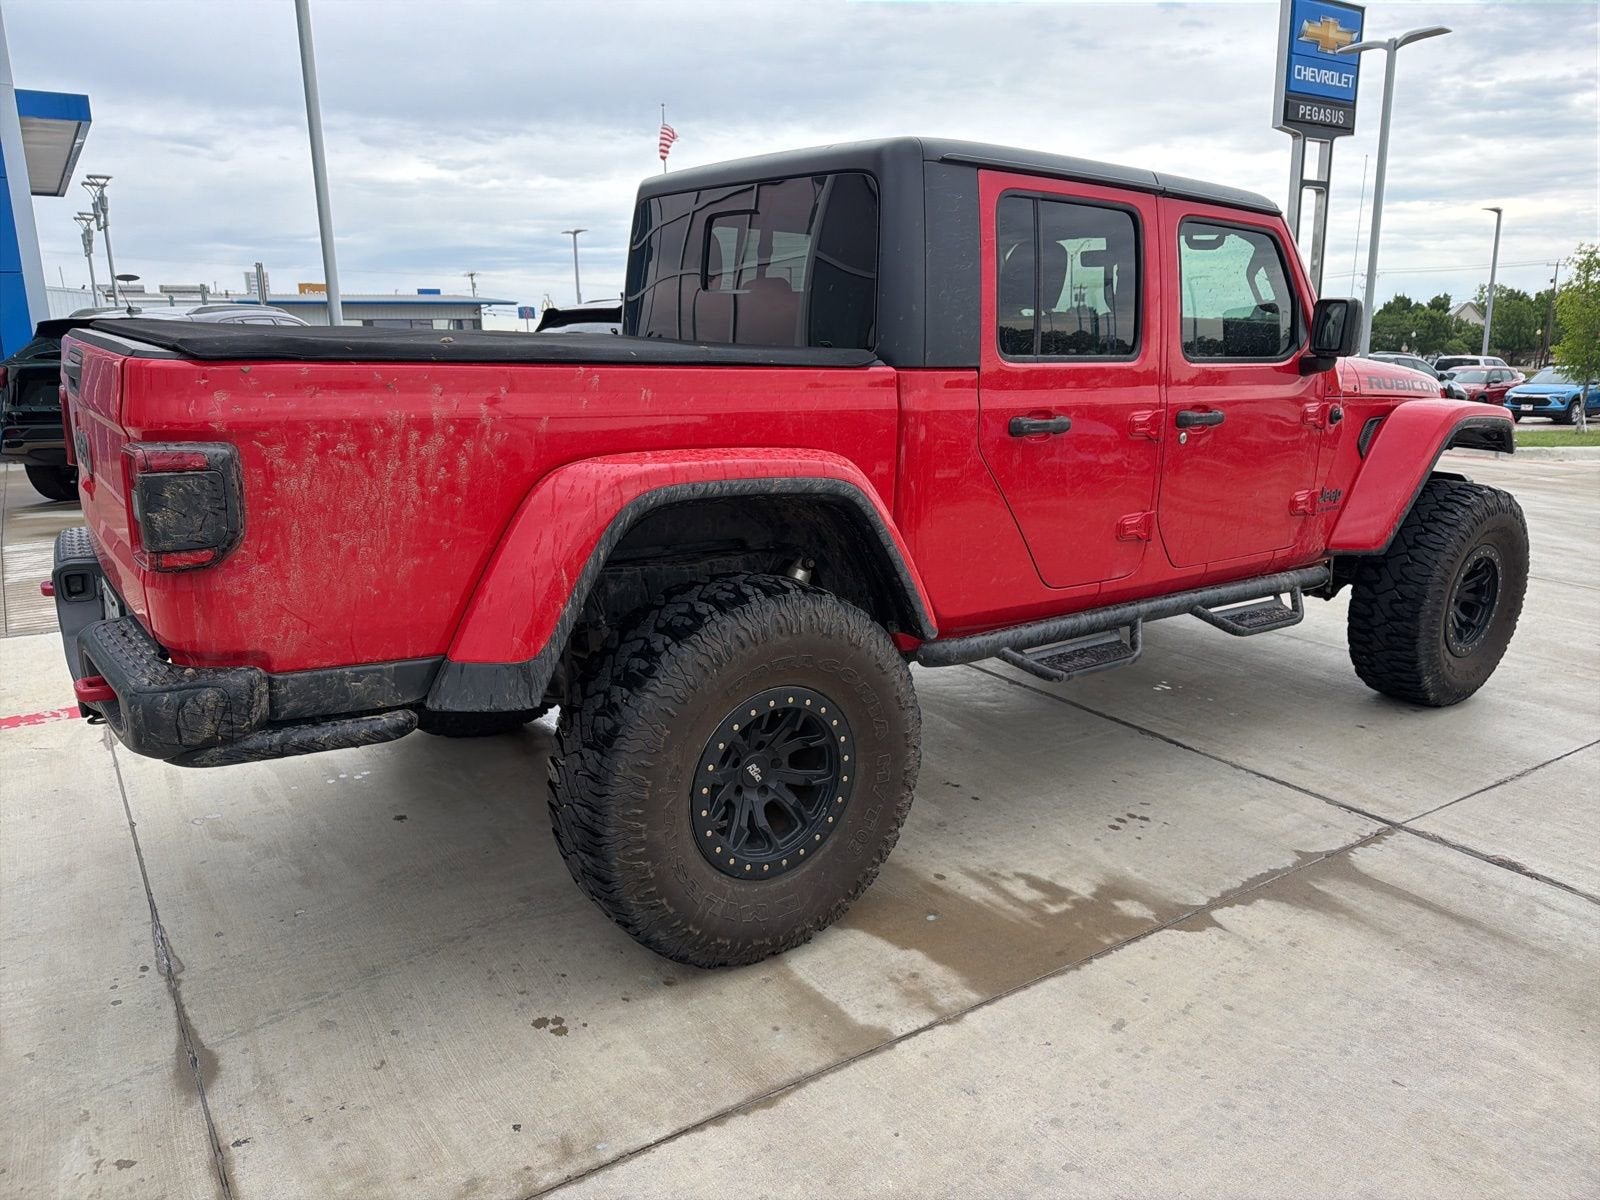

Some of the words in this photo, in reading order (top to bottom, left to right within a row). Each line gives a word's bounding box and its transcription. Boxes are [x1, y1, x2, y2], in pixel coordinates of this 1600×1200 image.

[1294, 64, 1355, 88] CHEVROLET
[1298, 104, 1345, 124] PEGASUS
[1367, 375, 1440, 393] RUBICON
[1317, 486, 1343, 504] Jeep
